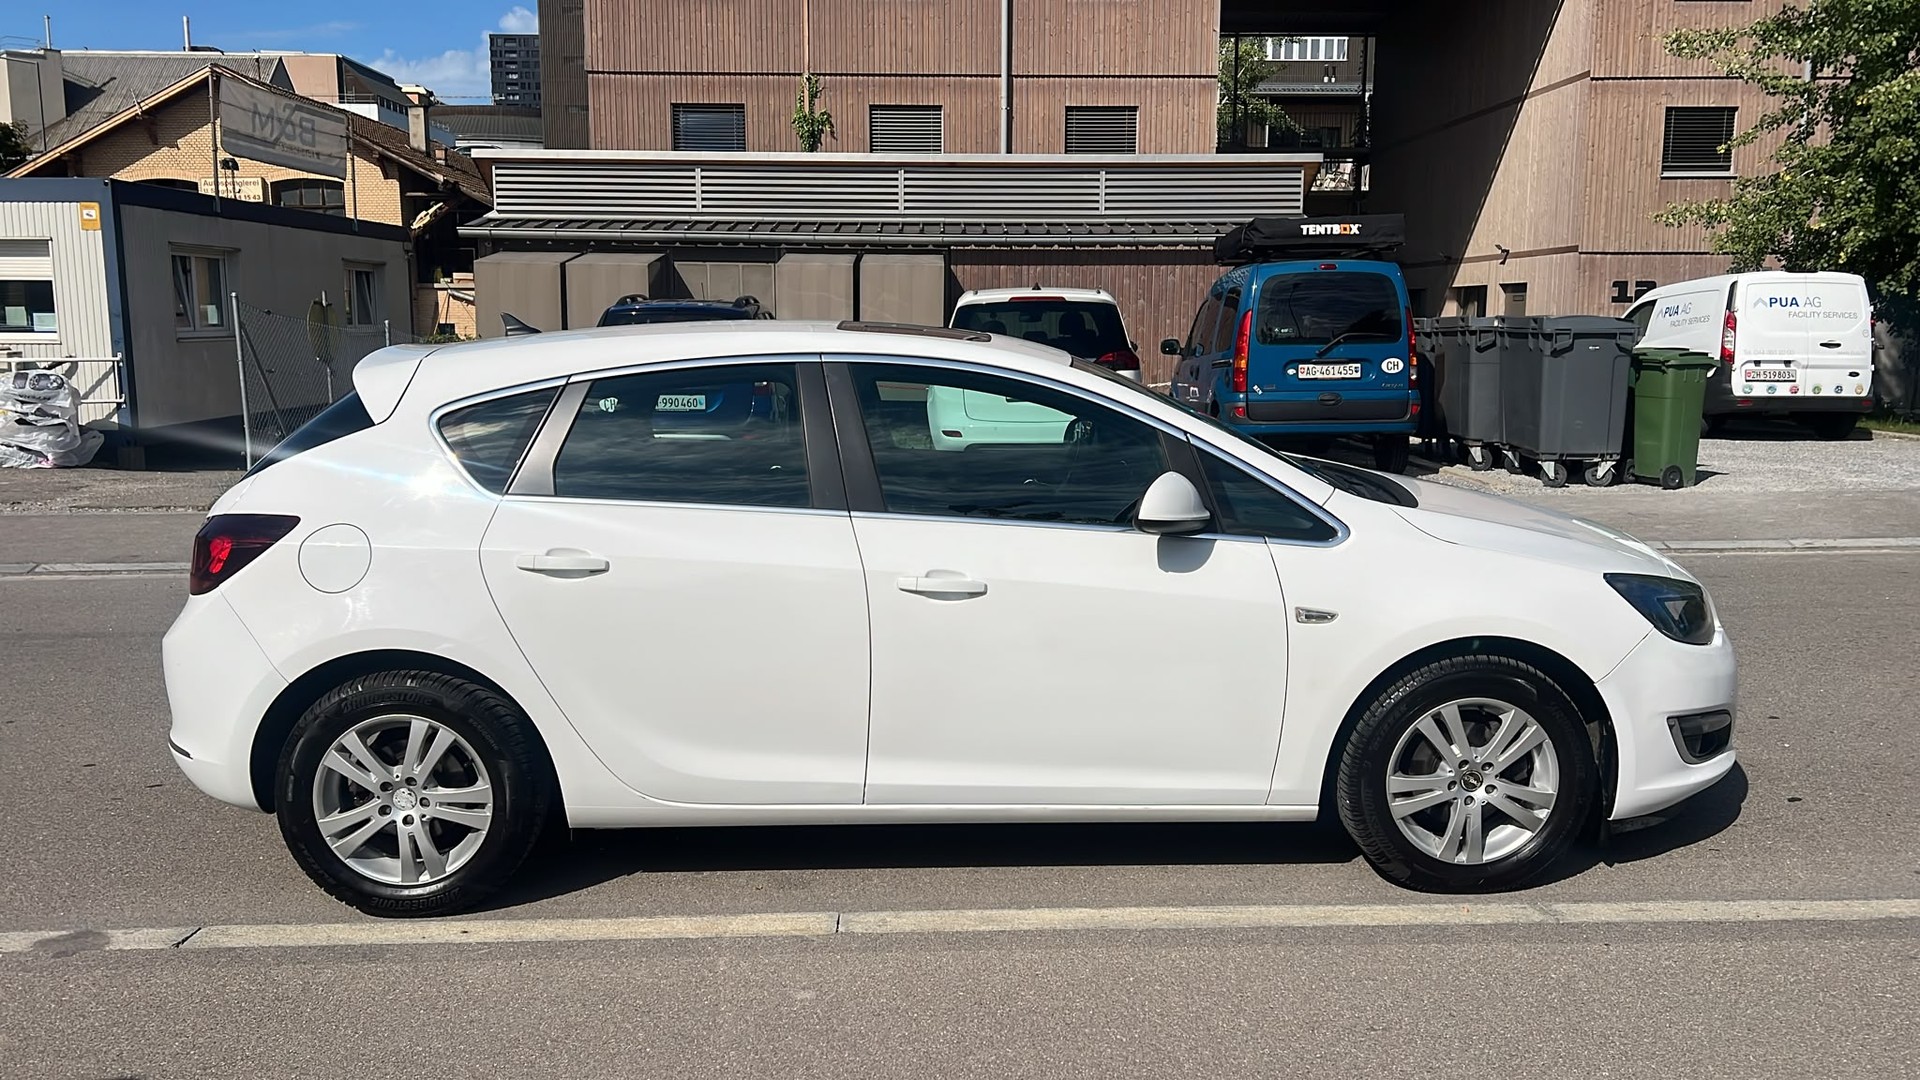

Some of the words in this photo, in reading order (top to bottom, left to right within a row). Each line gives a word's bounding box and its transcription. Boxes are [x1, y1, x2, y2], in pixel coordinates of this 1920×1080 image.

[1300, 224, 1360, 235] TENTBOX
[1769, 297, 1800, 308] PUA
[1803, 297, 1822, 307] AG
[1663, 304, 1680, 318] PUA
[1681, 302, 1692, 315] AG
[1788, 311, 1822, 319] FACILITY
[1823, 311, 1858, 320] SERVICES
[1670, 319, 1689, 328] FACILITY
[1688, 315, 1711, 326] SERVICES
[1386, 361, 1399, 371] CH
[1751, 371, 1761, 379] ZH
[604, 399, 616, 410] CH
